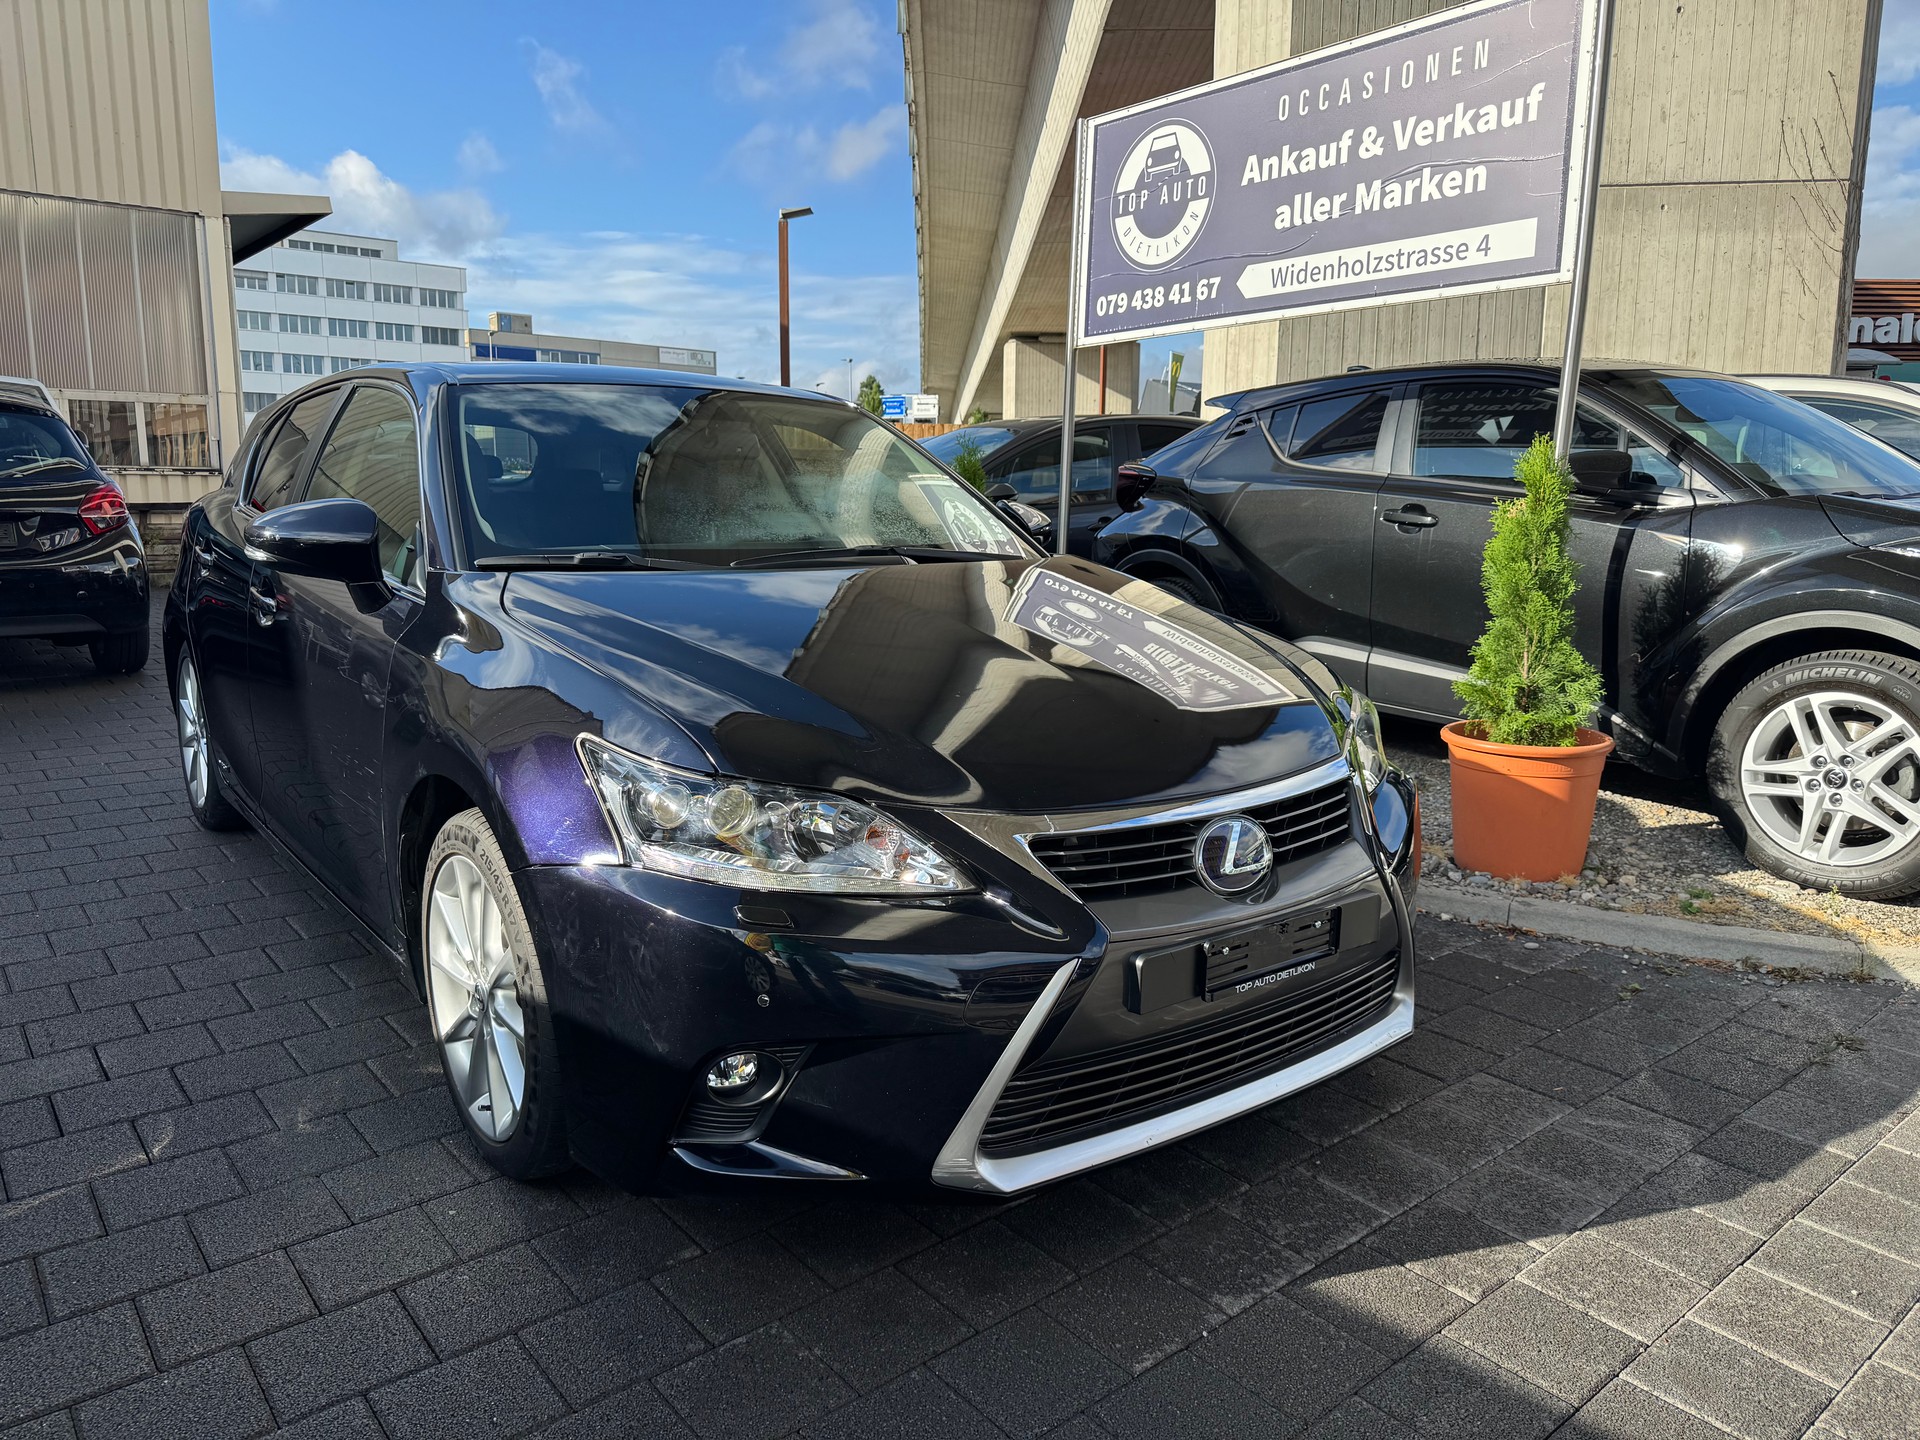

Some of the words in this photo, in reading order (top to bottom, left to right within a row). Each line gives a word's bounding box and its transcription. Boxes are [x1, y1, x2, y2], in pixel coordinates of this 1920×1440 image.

[1278, 38, 1490, 121] OCCASIONEN
[1241, 126, 1353, 186] Ankauf
[1358, 126, 1384, 159] &
[1392, 82, 1546, 155] Verkauf
[1118, 189, 1148, 215] TOP
[1160, 175, 1206, 205] AUTO
[1274, 191, 1347, 230] aller
[1355, 163, 1487, 216] Marken
[1123, 211, 1199, 257] DIETLIKON
[1270, 240, 1469, 289] Widenholzstrasse
[1475, 232, 1491, 257] 4
[1096, 292, 1128, 317] 079
[1131, 286, 1165, 311] 438
[1168, 281, 1192, 305] 41
[1197, 276, 1222, 301] 67
[1848, 313, 1920, 343] nal
[1785, 667, 1883, 685] MICHELIN
[479, 849, 504, 893] 215/45
[1235, 981, 1253, 994] TOP
[1253, 974, 1276, 988] AUTO
[1276, 961, 1316, 981] DIETLIKON
